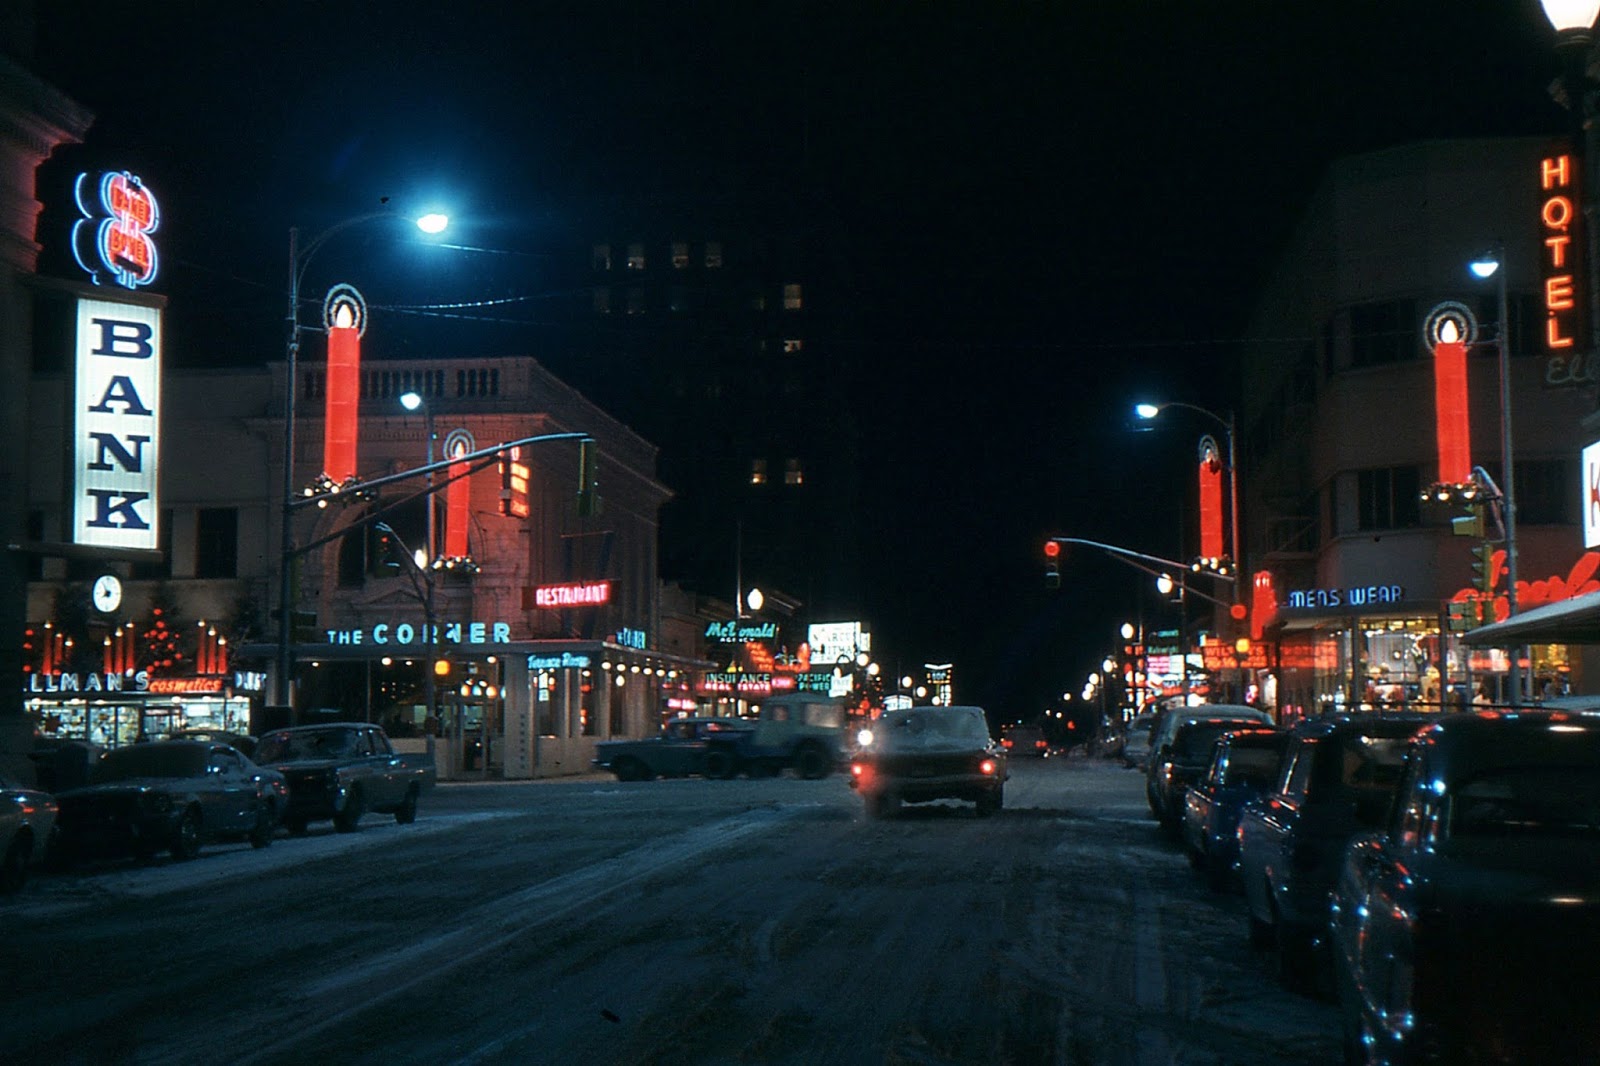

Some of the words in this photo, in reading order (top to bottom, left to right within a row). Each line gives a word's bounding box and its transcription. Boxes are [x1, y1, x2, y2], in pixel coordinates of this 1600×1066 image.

[1541, 155, 1574, 347] HOTEL
[86, 317, 154, 531] BANK
[536, 583, 608, 606] RESTAURANT
[1288, 588, 1341, 608] MENS
[1348, 585, 1402, 606] WEAR
[326, 630, 363, 645] THE
[372, 622, 511, 645] CORNER
